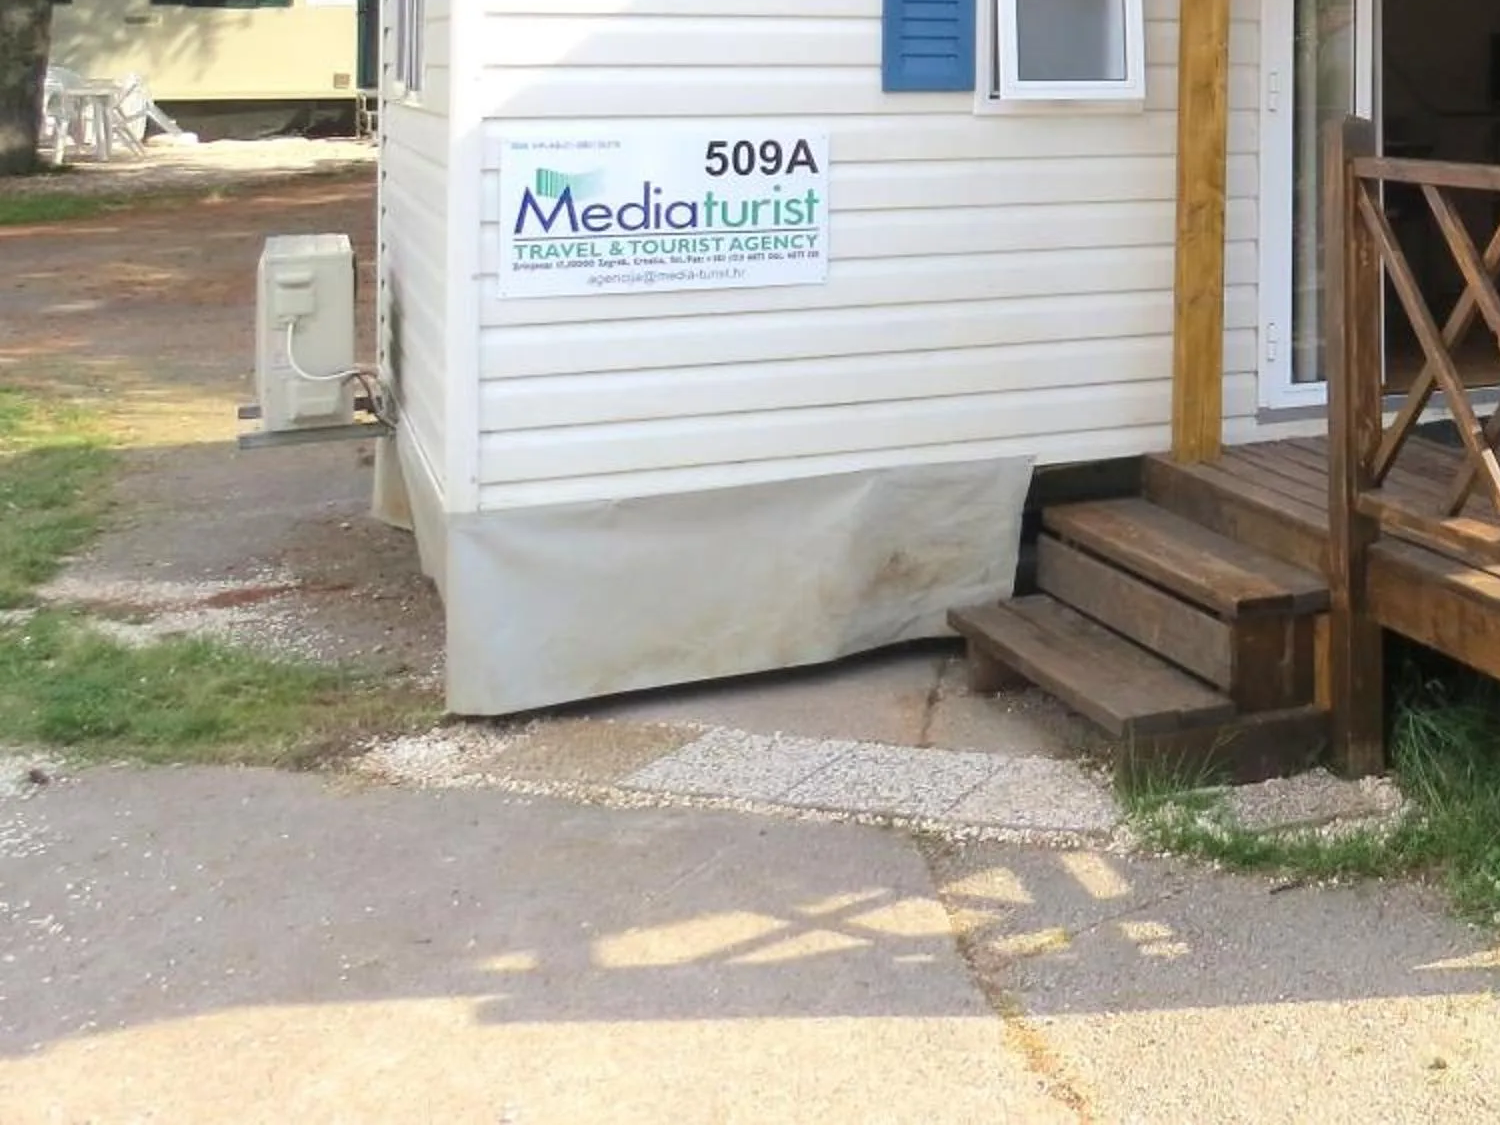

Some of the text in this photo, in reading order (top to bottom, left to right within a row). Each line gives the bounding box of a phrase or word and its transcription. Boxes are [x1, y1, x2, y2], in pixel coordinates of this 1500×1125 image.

[705, 138, 819, 176] 509A
[513, 180, 820, 234] Mediaturist
[514, 233, 819, 261] TRAVEL & TOURIST AGENCY
